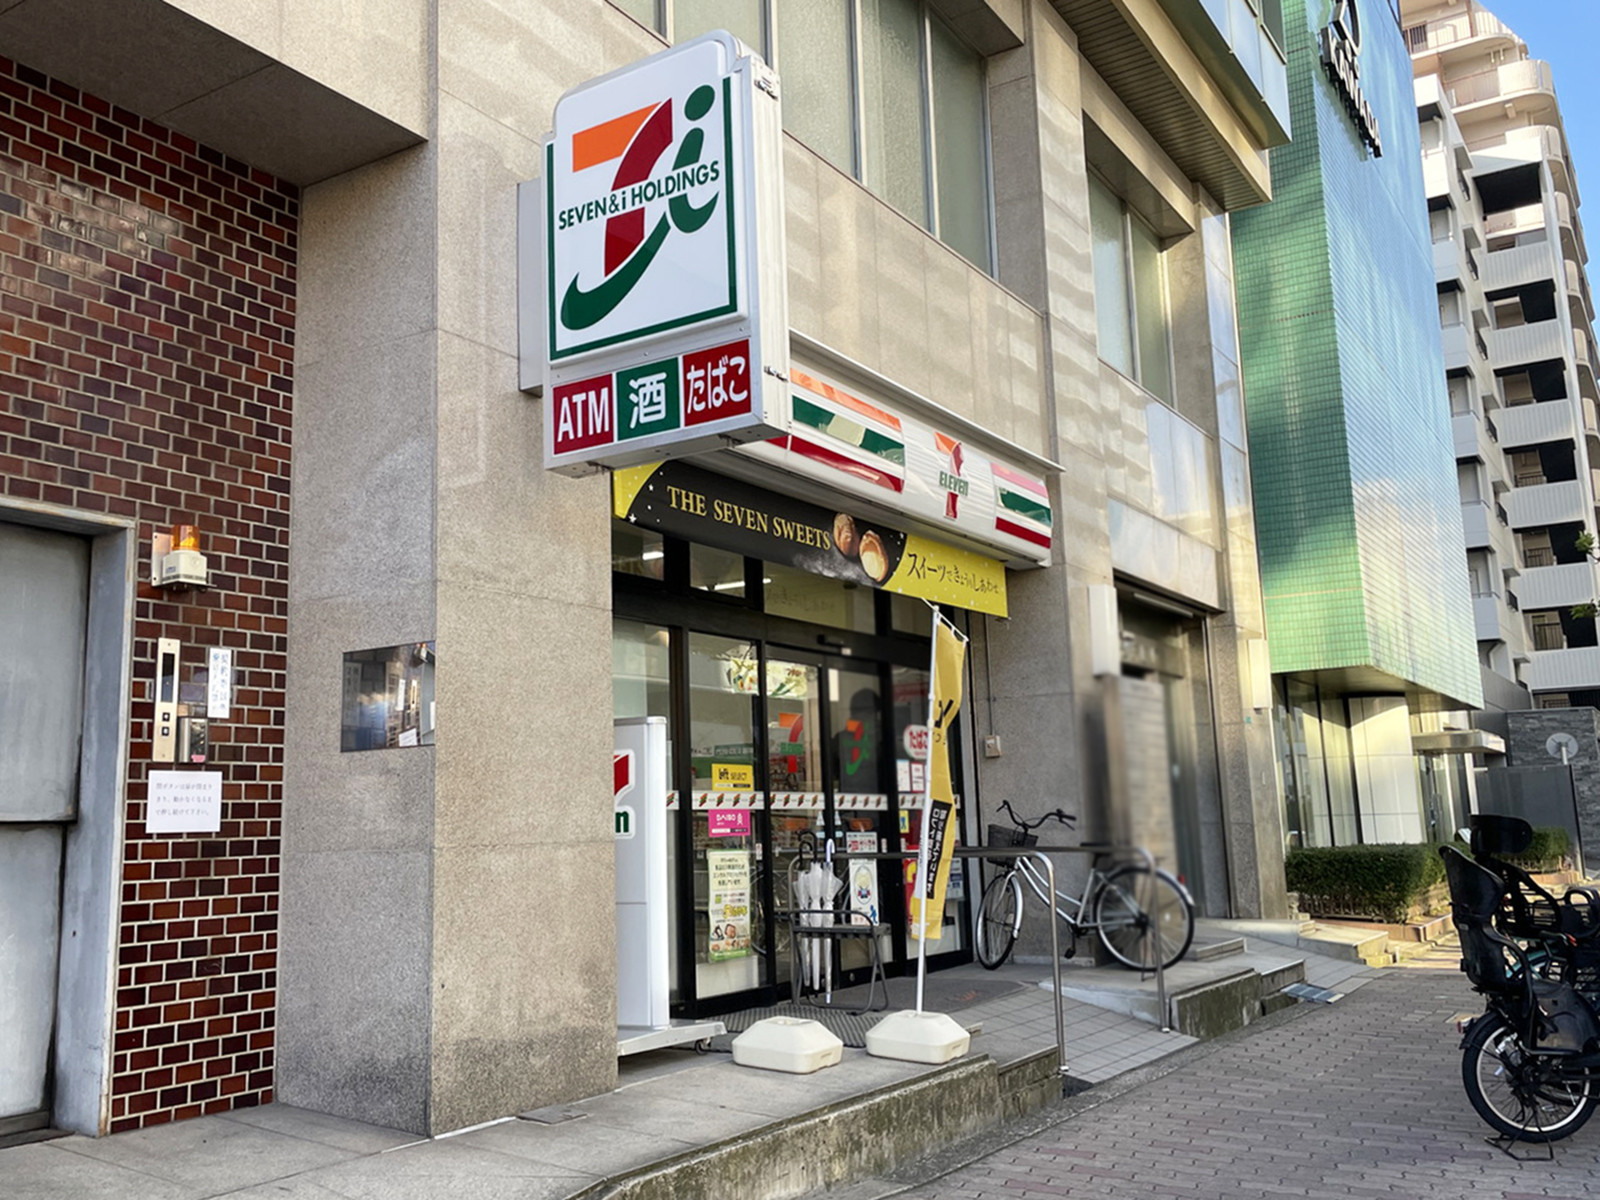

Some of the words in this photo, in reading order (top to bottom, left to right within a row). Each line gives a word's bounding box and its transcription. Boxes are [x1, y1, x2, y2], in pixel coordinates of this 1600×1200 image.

[631, 160, 720, 206] HOLDINGS
[628, 371, 668, 430] 酒
[686, 354, 749, 415] たばこ
[557, 386, 609, 443] ATM
[667, 485, 707, 517] THE
[713, 499, 768, 533] SEVEN
[773, 516, 831, 551] SWEETS
